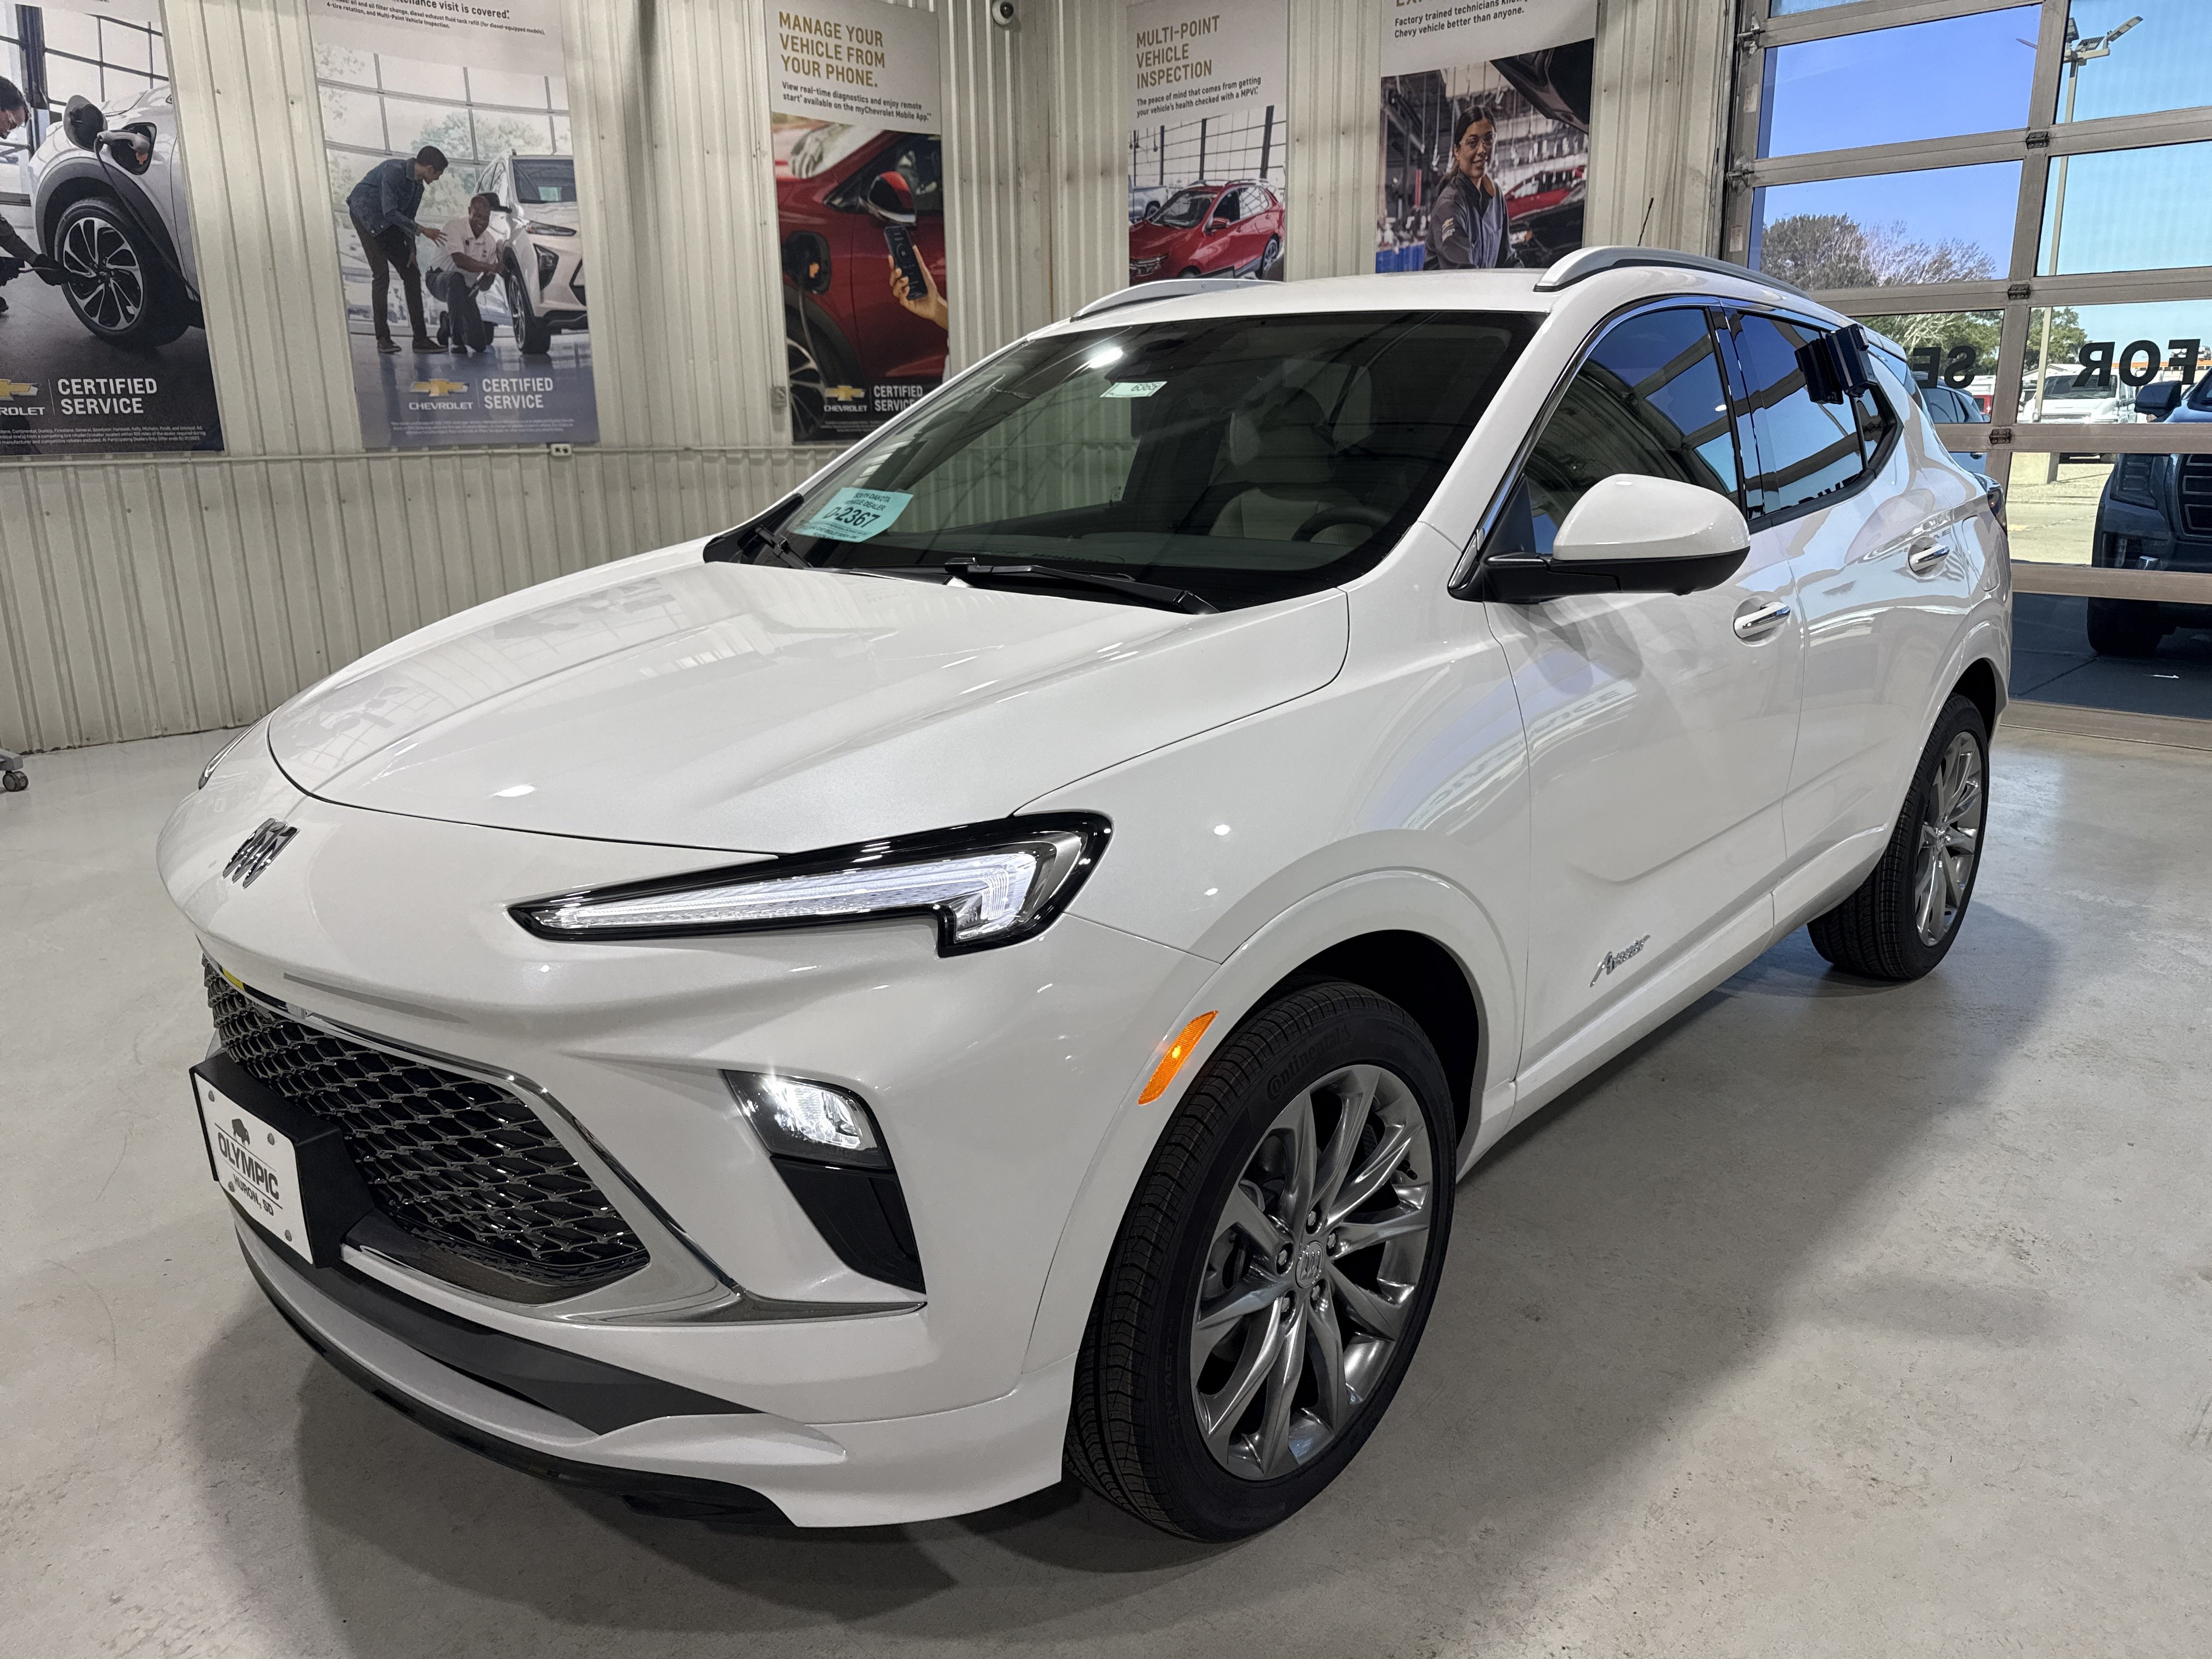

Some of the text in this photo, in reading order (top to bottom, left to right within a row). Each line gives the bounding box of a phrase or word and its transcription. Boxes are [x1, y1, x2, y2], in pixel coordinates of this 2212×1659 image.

[343, 6, 365, 15] rotation,
[376, 12, 405, 22] Multi-Point
[406, 16, 423, 24] Vehicle
[390, 7, 409, 15] change,
[439, 1, 459, 12] visit
[461, 3, 469, 13] is
[1395, 15, 1423, 27] Factory
[1425, 7, 1452, 21] trained
[1454, 0, 1499, 15] technicians
[779, 11, 883, 48] MANAGE YOUR
[1137, 14, 1220, 48] MULTI-POINT
[1395, 7, 1524, 38] Chevy vehicle better than anyone.
[780, 32, 885, 68] VEHICLE FROM
[1136, 43, 1189, 68] VEHICLE
[781, 54, 878, 87] YOUR PHONE.
[1137, 59, 1212, 89] INSPECTION
[782, 81, 799, 91] View
[800, 86, 831, 97] real-time
[832, 90, 868, 103] diagnostics
[883, 99, 899, 109] enjoy
[900, 102, 922, 110] remote
[1137, 76, 1261, 106] The peace of mind that comes from getting
[804, 98, 833, 108] available
[843, 103, 854, 111] the
[855, 106, 894, 117] myChevrolet
[895, 110, 915, 120] Mobile
[1137, 109, 1149, 119] your
[1150, 102, 1174, 114] vehicle's
[1175, 99, 1194, 110] health
[1195, 94, 1220, 106] checked
[1220, 91, 1234, 101] with
[58, 377, 157, 395] CERTIFIED
[482, 377, 554, 392] CERTIFIED
[873, 385, 923, 397] CERTIFIED
[61, 398, 144, 415] SERVICE
[409, 401, 473, 410] CHEVROLET
[484, 394, 544, 409] SERVICE
[823, 404, 868, 413] CHEVROLET
[862, 501, 886, 511] DEALER
[868, 493, 890, 504] DAKOTA
[823, 506, 881, 528] D-2367
[218, 1132, 279, 1200] OLYMPIC
[233, 1173, 274, 1216] HURON, SD
